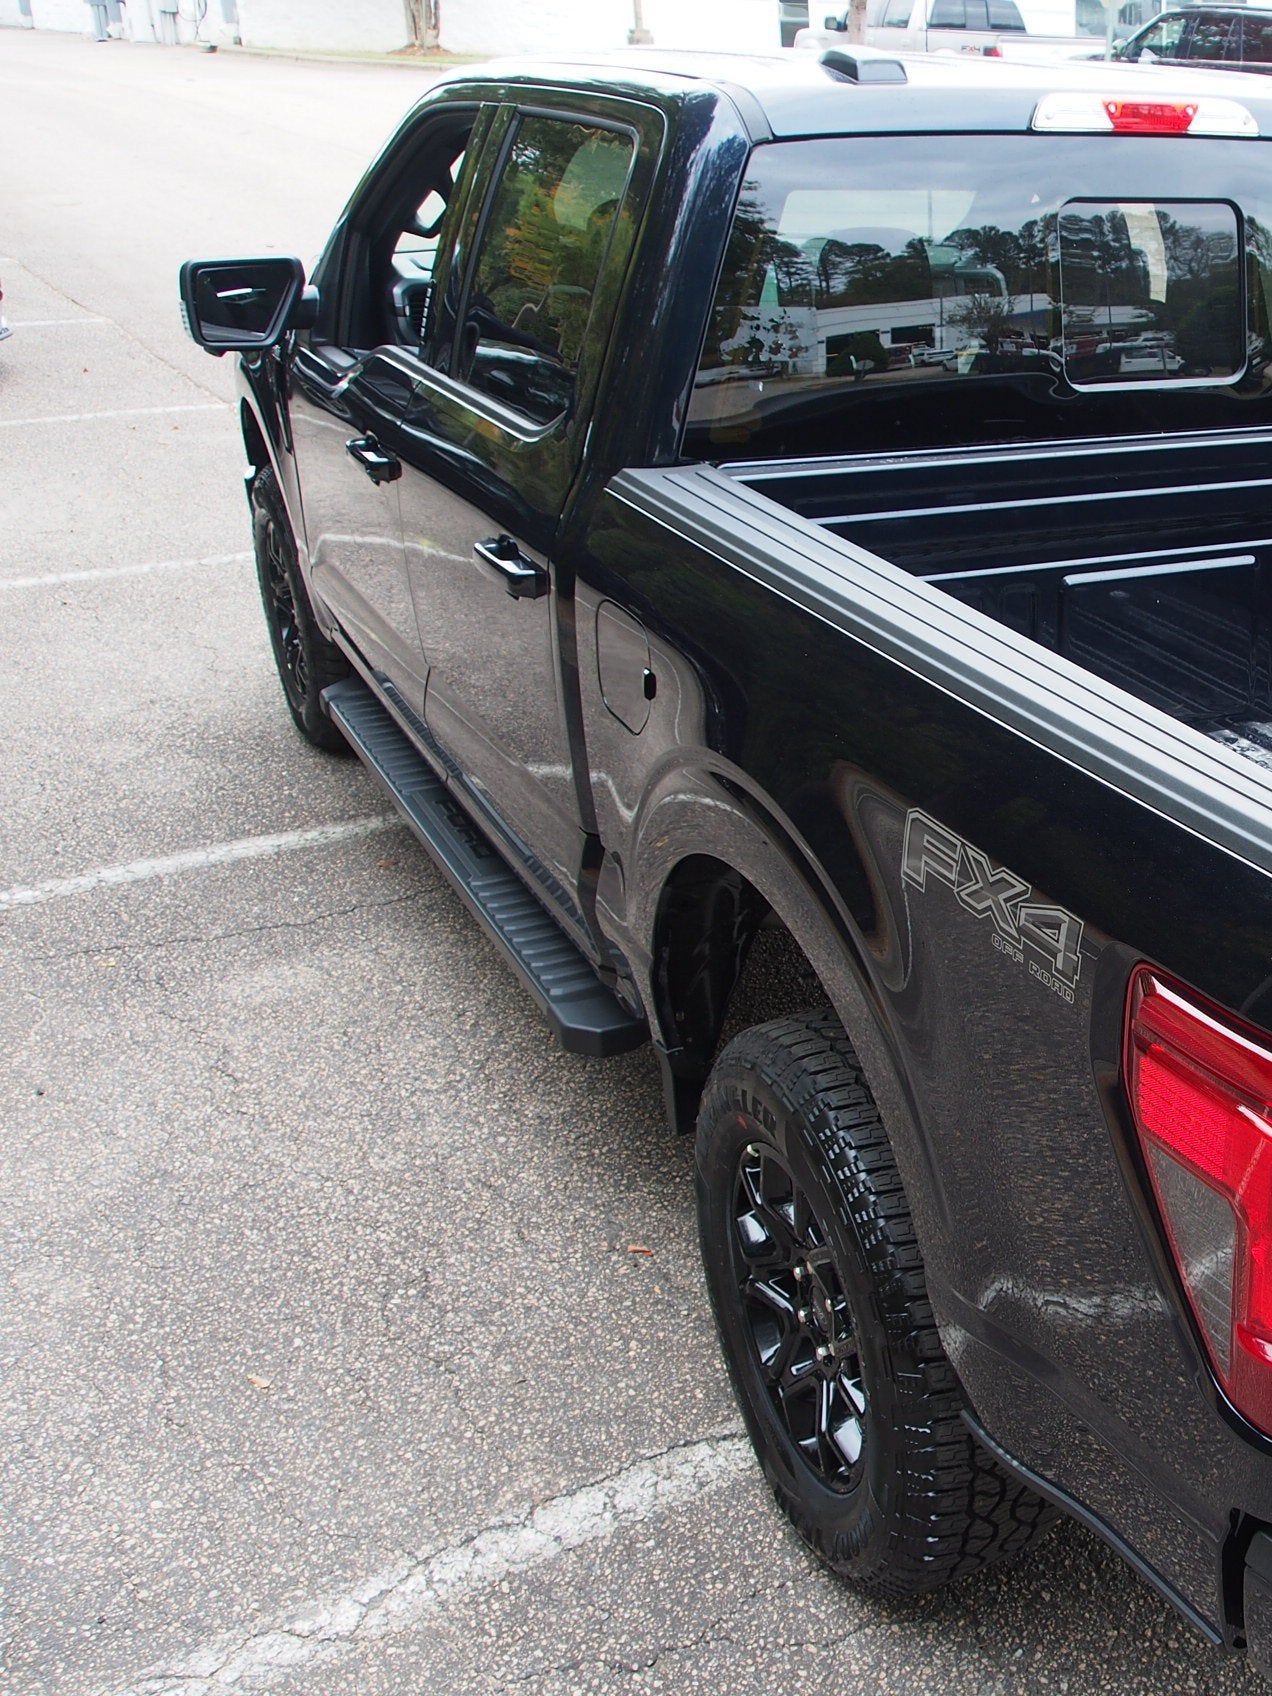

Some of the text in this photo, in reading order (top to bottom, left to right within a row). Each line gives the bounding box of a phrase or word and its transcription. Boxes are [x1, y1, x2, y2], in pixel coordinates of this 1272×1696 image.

[901, 807, 1084, 988] FX4
[992, 933, 1075, 1004] OFF ROAD
